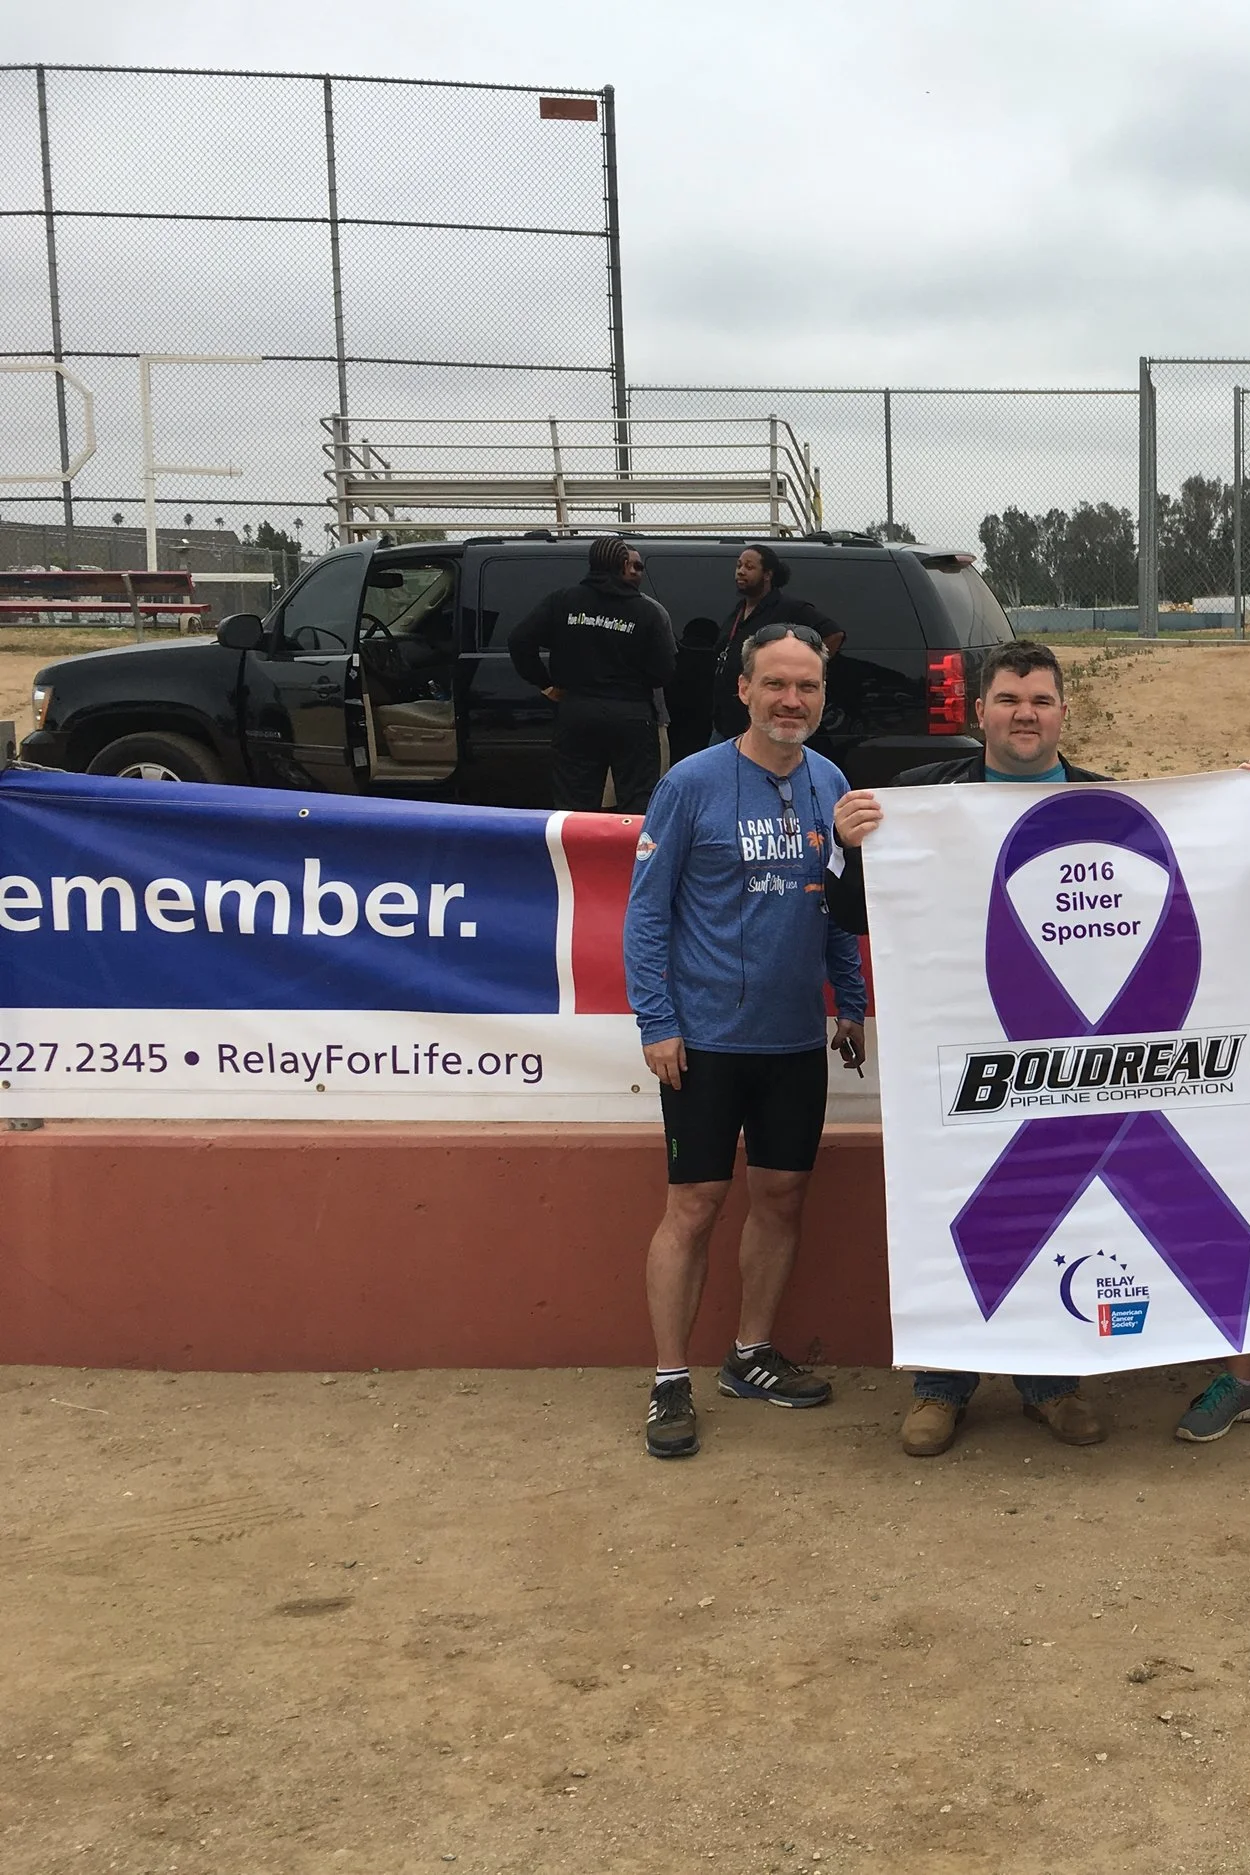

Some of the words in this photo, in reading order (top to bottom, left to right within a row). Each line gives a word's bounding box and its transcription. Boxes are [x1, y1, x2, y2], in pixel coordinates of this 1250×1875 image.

[738, 820, 744, 836] I
[747, 818, 774, 836] RAN
[742, 834, 804, 861] BEACH!
[1059, 861, 1115, 884] 2016
[785, 881, 798, 889] USA
[0, 858, 478, 938] emember.
[1055, 890, 1123, 912] Silver
[1041, 917, 1141, 945] Sponsor
[0, 1042, 168, 1073] 227.2345
[218, 1043, 544, 1083] RelayForLife.org
[947, 1033, 1248, 1117] BOUDREAU
[1010, 1092, 1091, 1108] PIPELINE
[1096, 1082, 1234, 1101] CORPORATION
[1096, 1275, 1135, 1288] RELAY
[1097, 1288, 1121, 1299] FOR
[1124, 1286, 1149, 1297] LIFE
[1112, 1309, 1143, 1317] American
